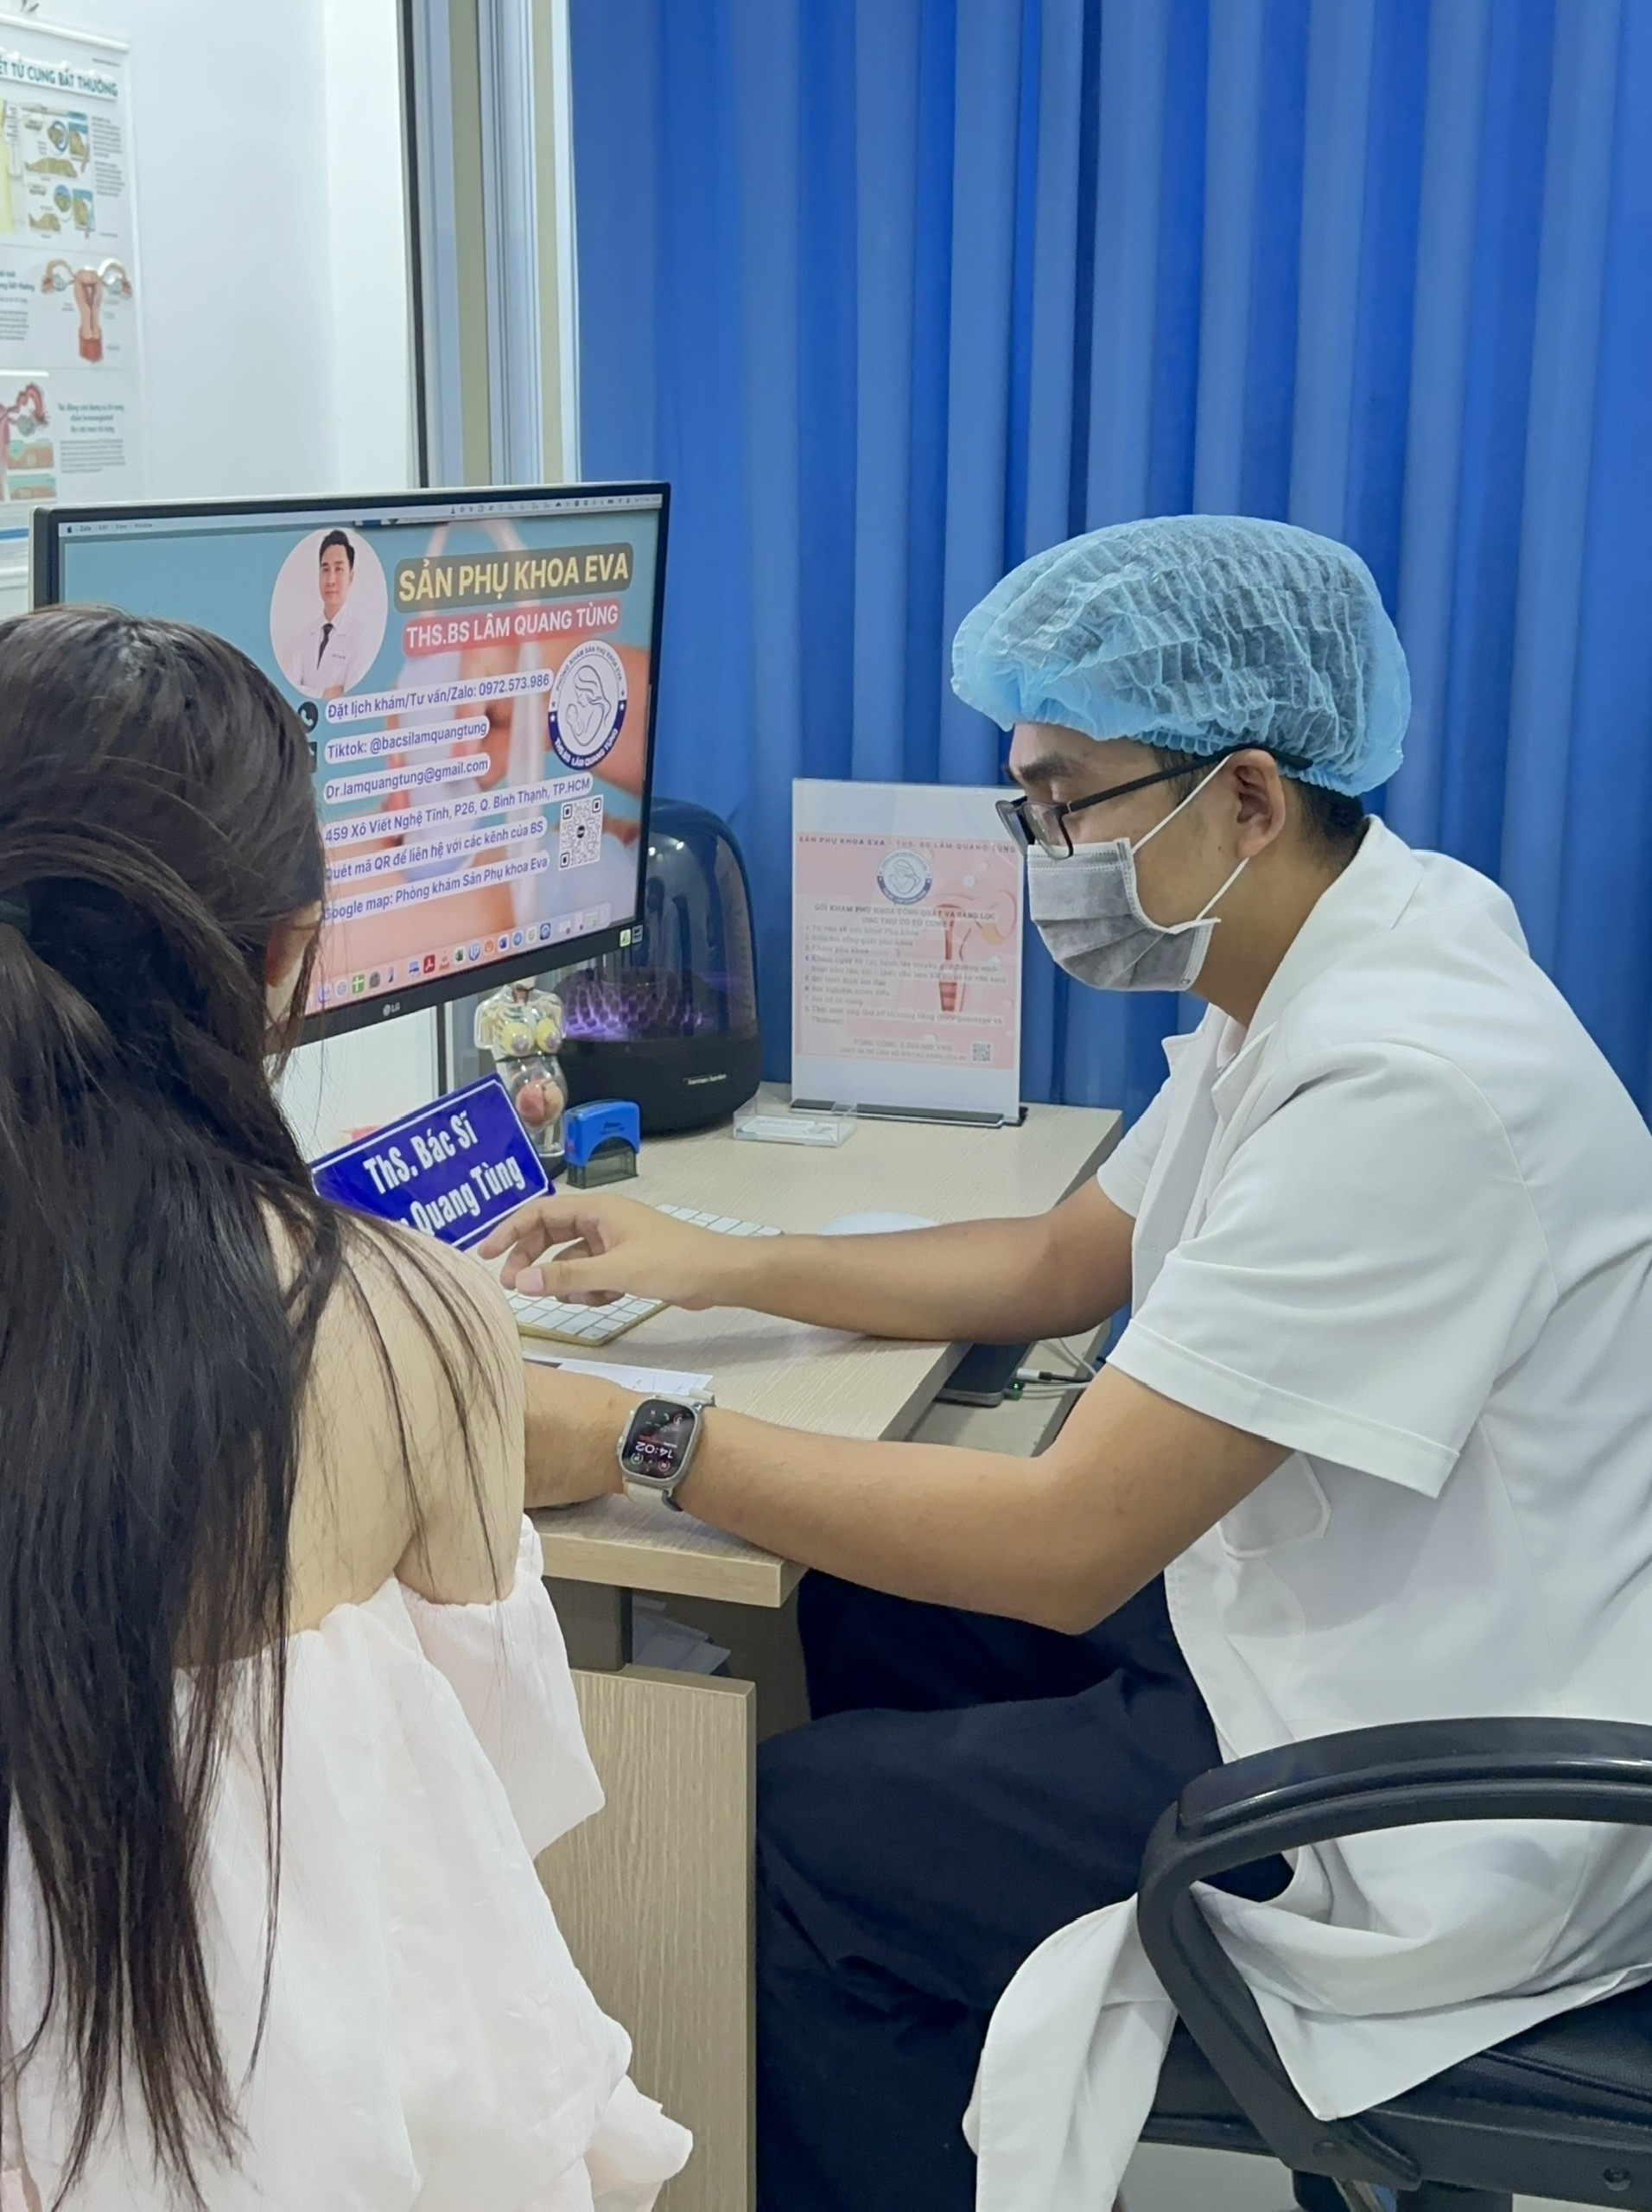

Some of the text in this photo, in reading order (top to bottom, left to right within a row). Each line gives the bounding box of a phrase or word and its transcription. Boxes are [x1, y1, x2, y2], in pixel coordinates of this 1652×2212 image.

[27, 67, 55, 85] CUNG
[399, 552, 629, 601] SẢN PHỤ KHOA EVA
[406, 601, 619, 649] THS.BS LÂM QUANG TÙNG
[327, 702, 348, 720] Đặt
[352, 701, 372, 718] lịch
[479, 673, 550, 696] 0972.573.986
[328, 723, 487, 759] Tiktok: @bacsilamquangtung
[326, 759, 488, 798] Dr.lamquangtung@gmail.com
[326, 826, 348, 842] 459
[351, 823, 366, 837] Xô
[369, 817, 391, 834] Viết
[394, 810, 423, 830] Nghệ
[454, 801, 478, 817] P26,
[480, 799, 491, 811] Q.
[518, 787, 550, 804] Thạnh,
[553, 778, 591, 796] TP.HCM
[354, 859, 372, 874] mã
[374, 855, 391, 870] QR
[393, 849, 407, 865] để
[409, 846, 429, 862] liên
[430, 842, 444, 859] hệ
[464, 836, 482, 849] các
[484, 829, 509, 845] kênh
[511, 825, 529, 837] của
[531, 821, 543, 834] BS
[366, 894, 393, 911] map:
[396, 886, 430, 903] Phòng
[432, 877, 461, 894] khám
[463, 871, 482, 887] Sản
[484, 866, 503, 882] Phụ
[505, 862, 528, 877] khoa
[531, 857, 548, 870] Eva
[391, 1002, 401, 1012] LG
[362, 1109, 479, 1194] ThS. Bác Sĩ
[410, 1155, 526, 1237] Quang Tùng
[636, 1441, 673, 1459] 14:02
